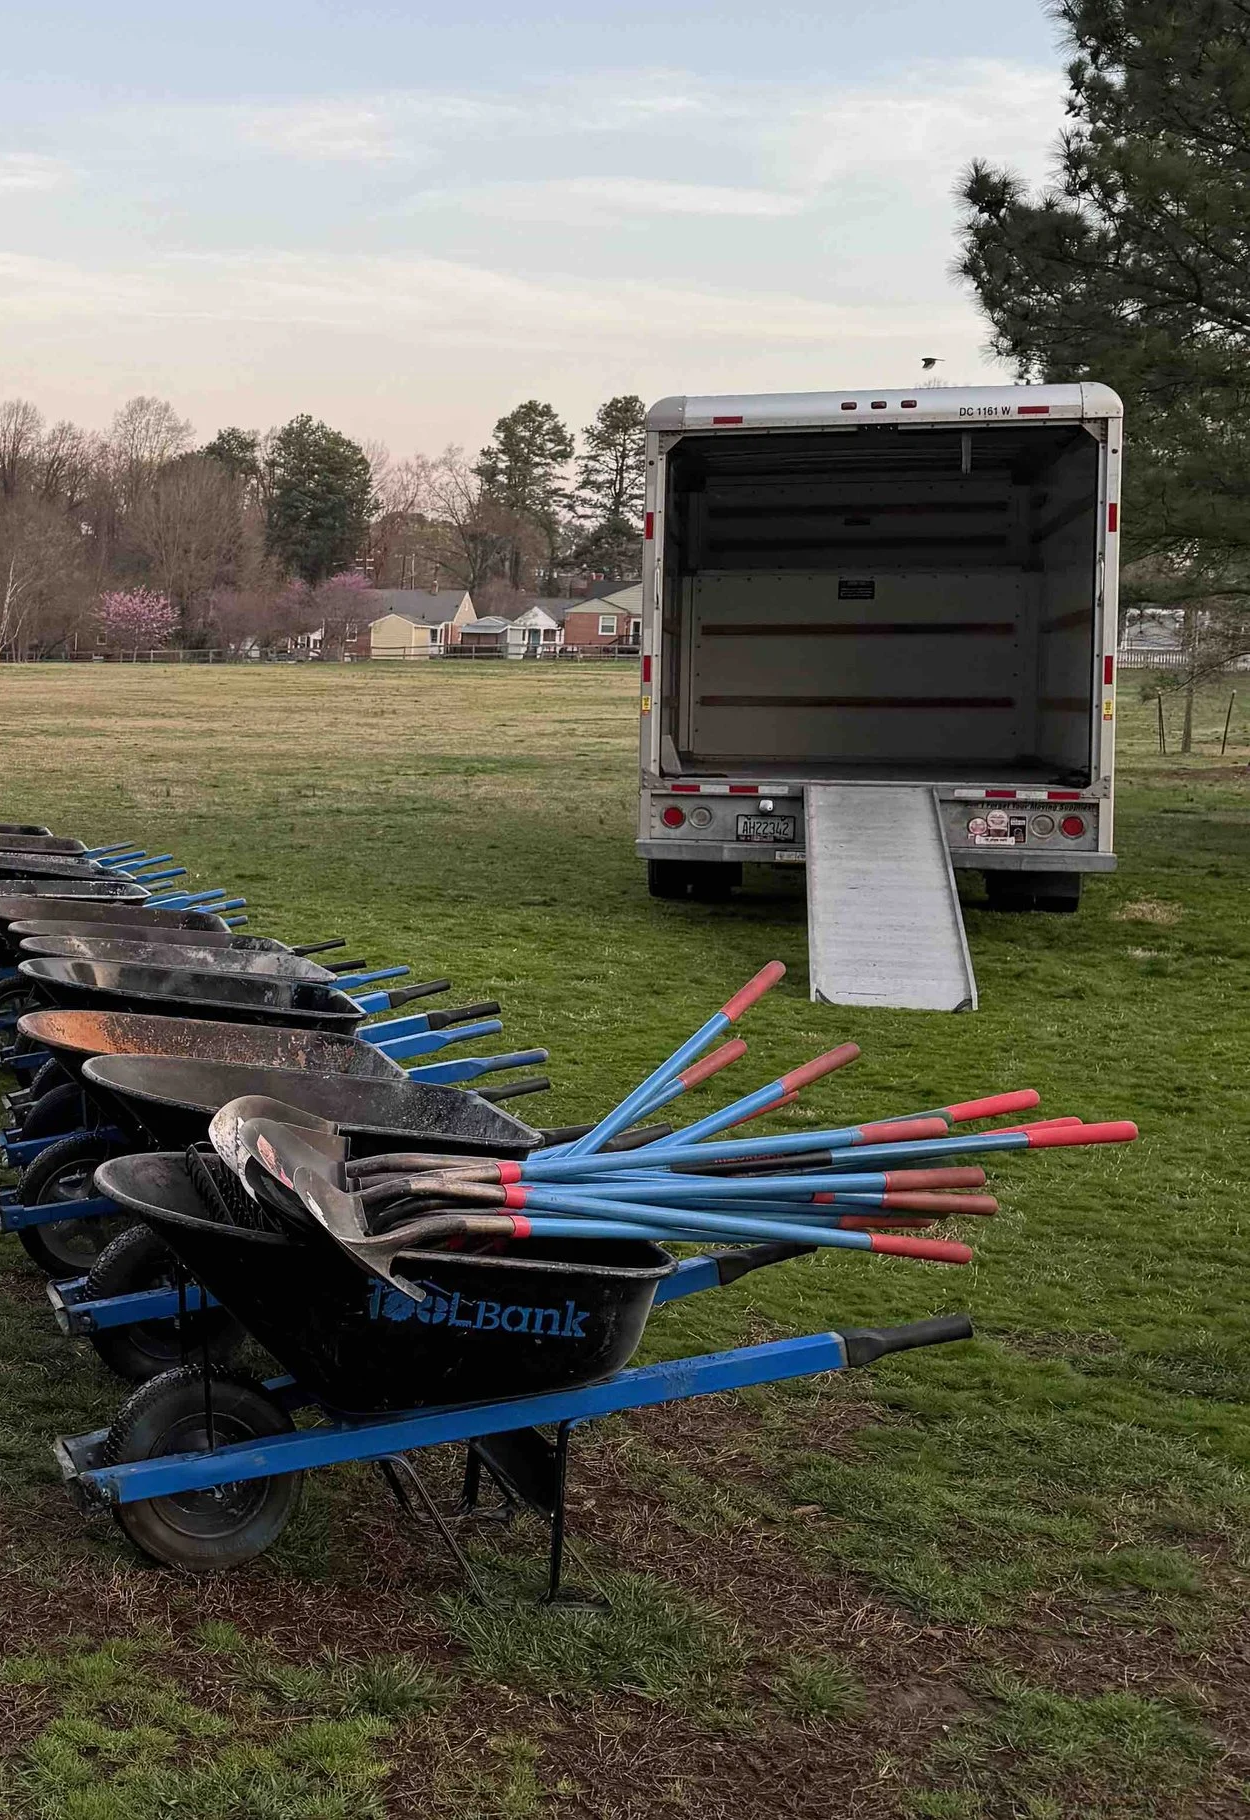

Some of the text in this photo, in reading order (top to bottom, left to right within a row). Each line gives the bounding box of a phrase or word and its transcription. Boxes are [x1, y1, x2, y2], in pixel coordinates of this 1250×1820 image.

[959, 405, 1011, 416] DC 1161 W
[742, 821, 789, 836] AH22342
